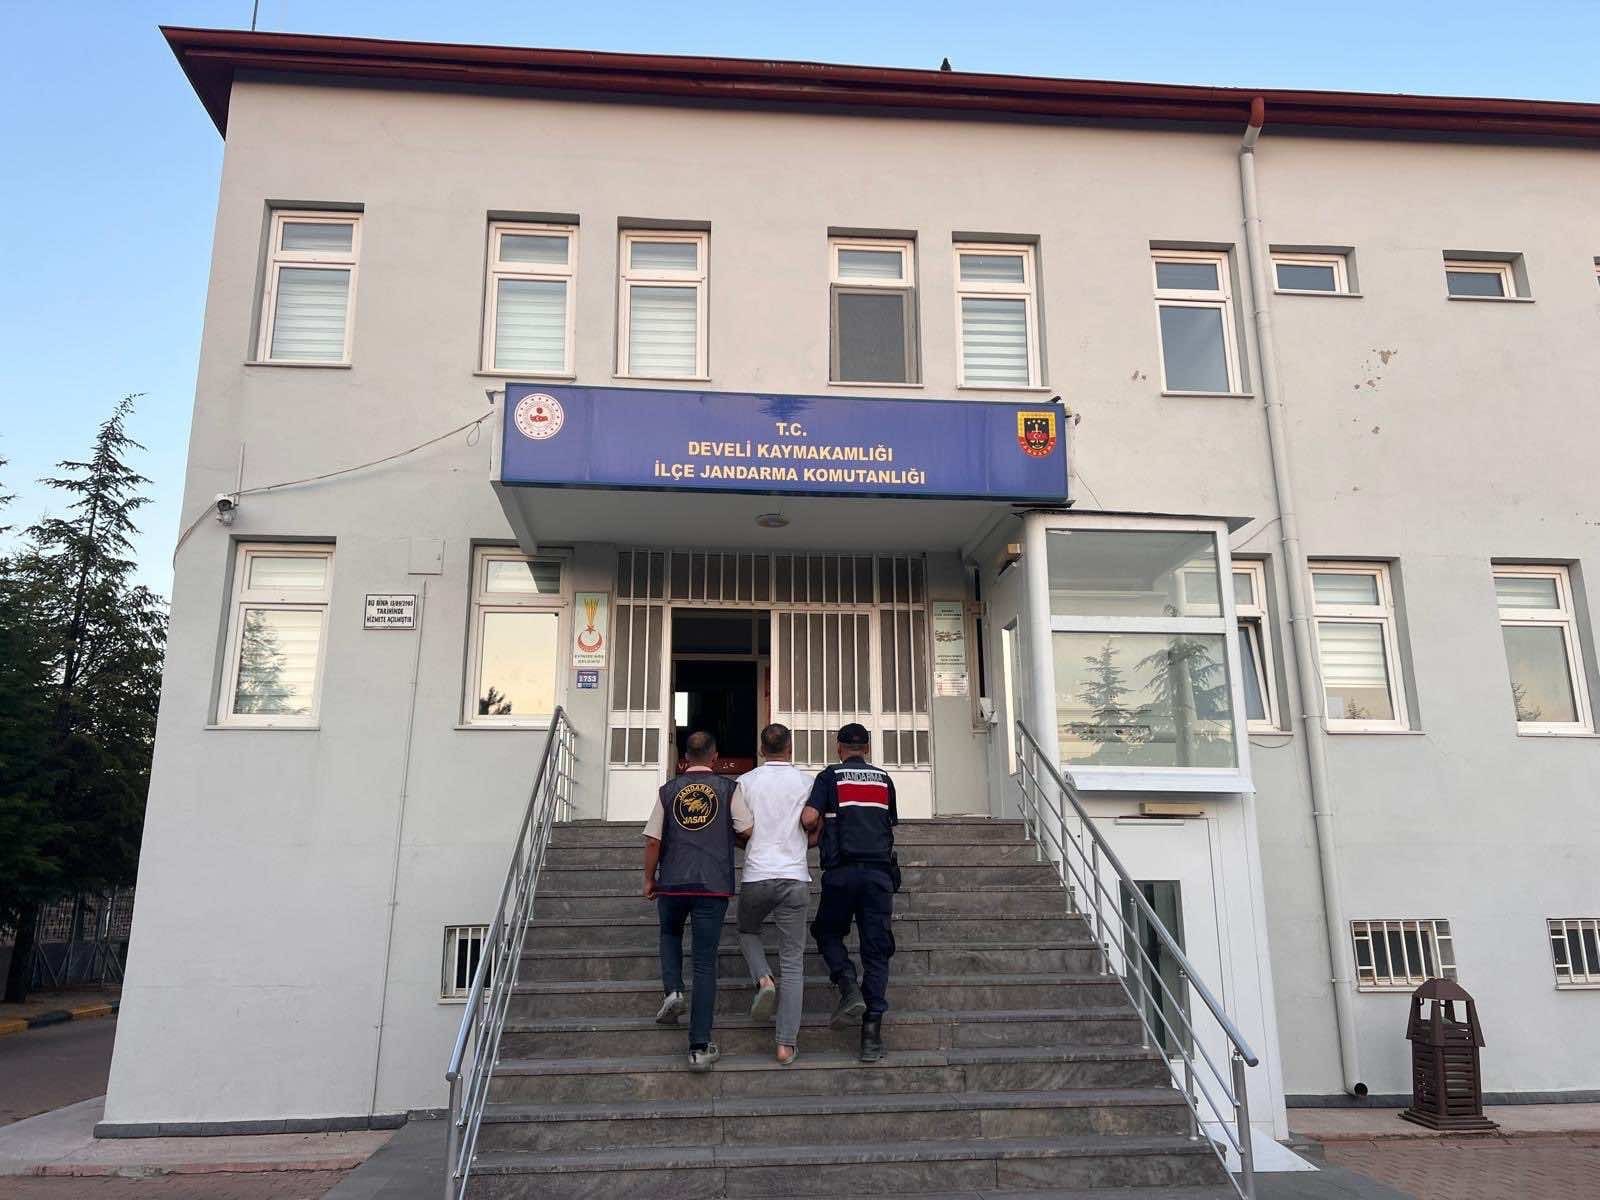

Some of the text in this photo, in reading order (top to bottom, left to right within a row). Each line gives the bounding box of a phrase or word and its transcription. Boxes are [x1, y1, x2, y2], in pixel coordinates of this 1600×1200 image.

[776, 422, 807, 436] T.C.
[688, 440, 893, 462] DEVELİ KAYMAKAMLIĞI
[654, 459, 926, 485] İLÇE JANDARMA KOMUTANLIĞI
[842, 771, 883, 782] JANDARMA
[679, 784, 714, 800] JANDARMA
[683, 815, 708, 824] JASAT
